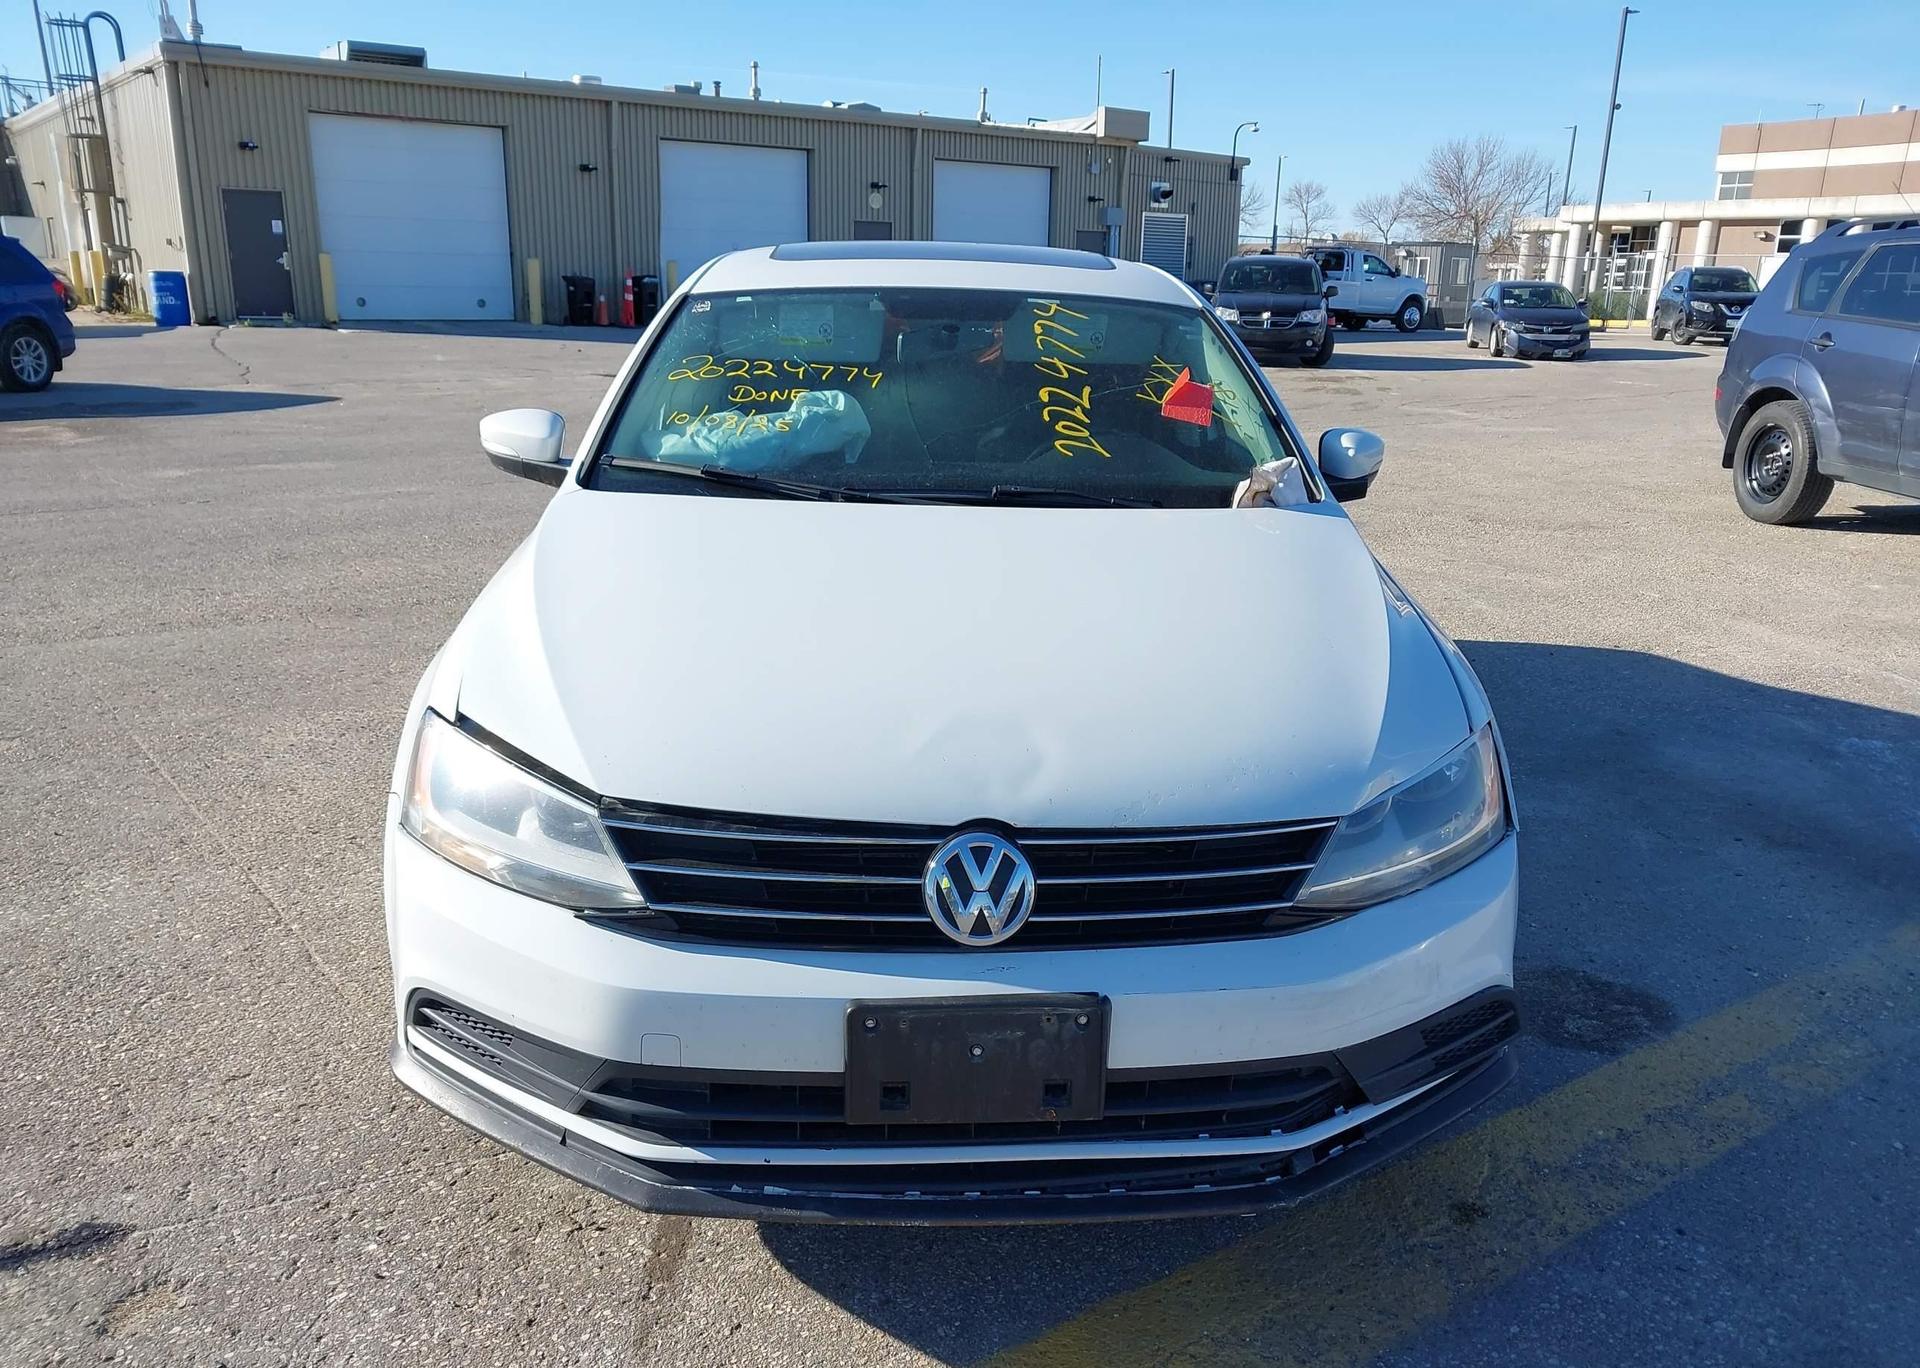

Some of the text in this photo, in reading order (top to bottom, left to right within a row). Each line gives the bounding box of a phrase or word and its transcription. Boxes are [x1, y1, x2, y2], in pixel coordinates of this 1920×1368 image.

[668, 355, 884, 389] 20224774
[1033, 301, 1111, 457] 20224774
[728, 384, 810, 403] DONE
